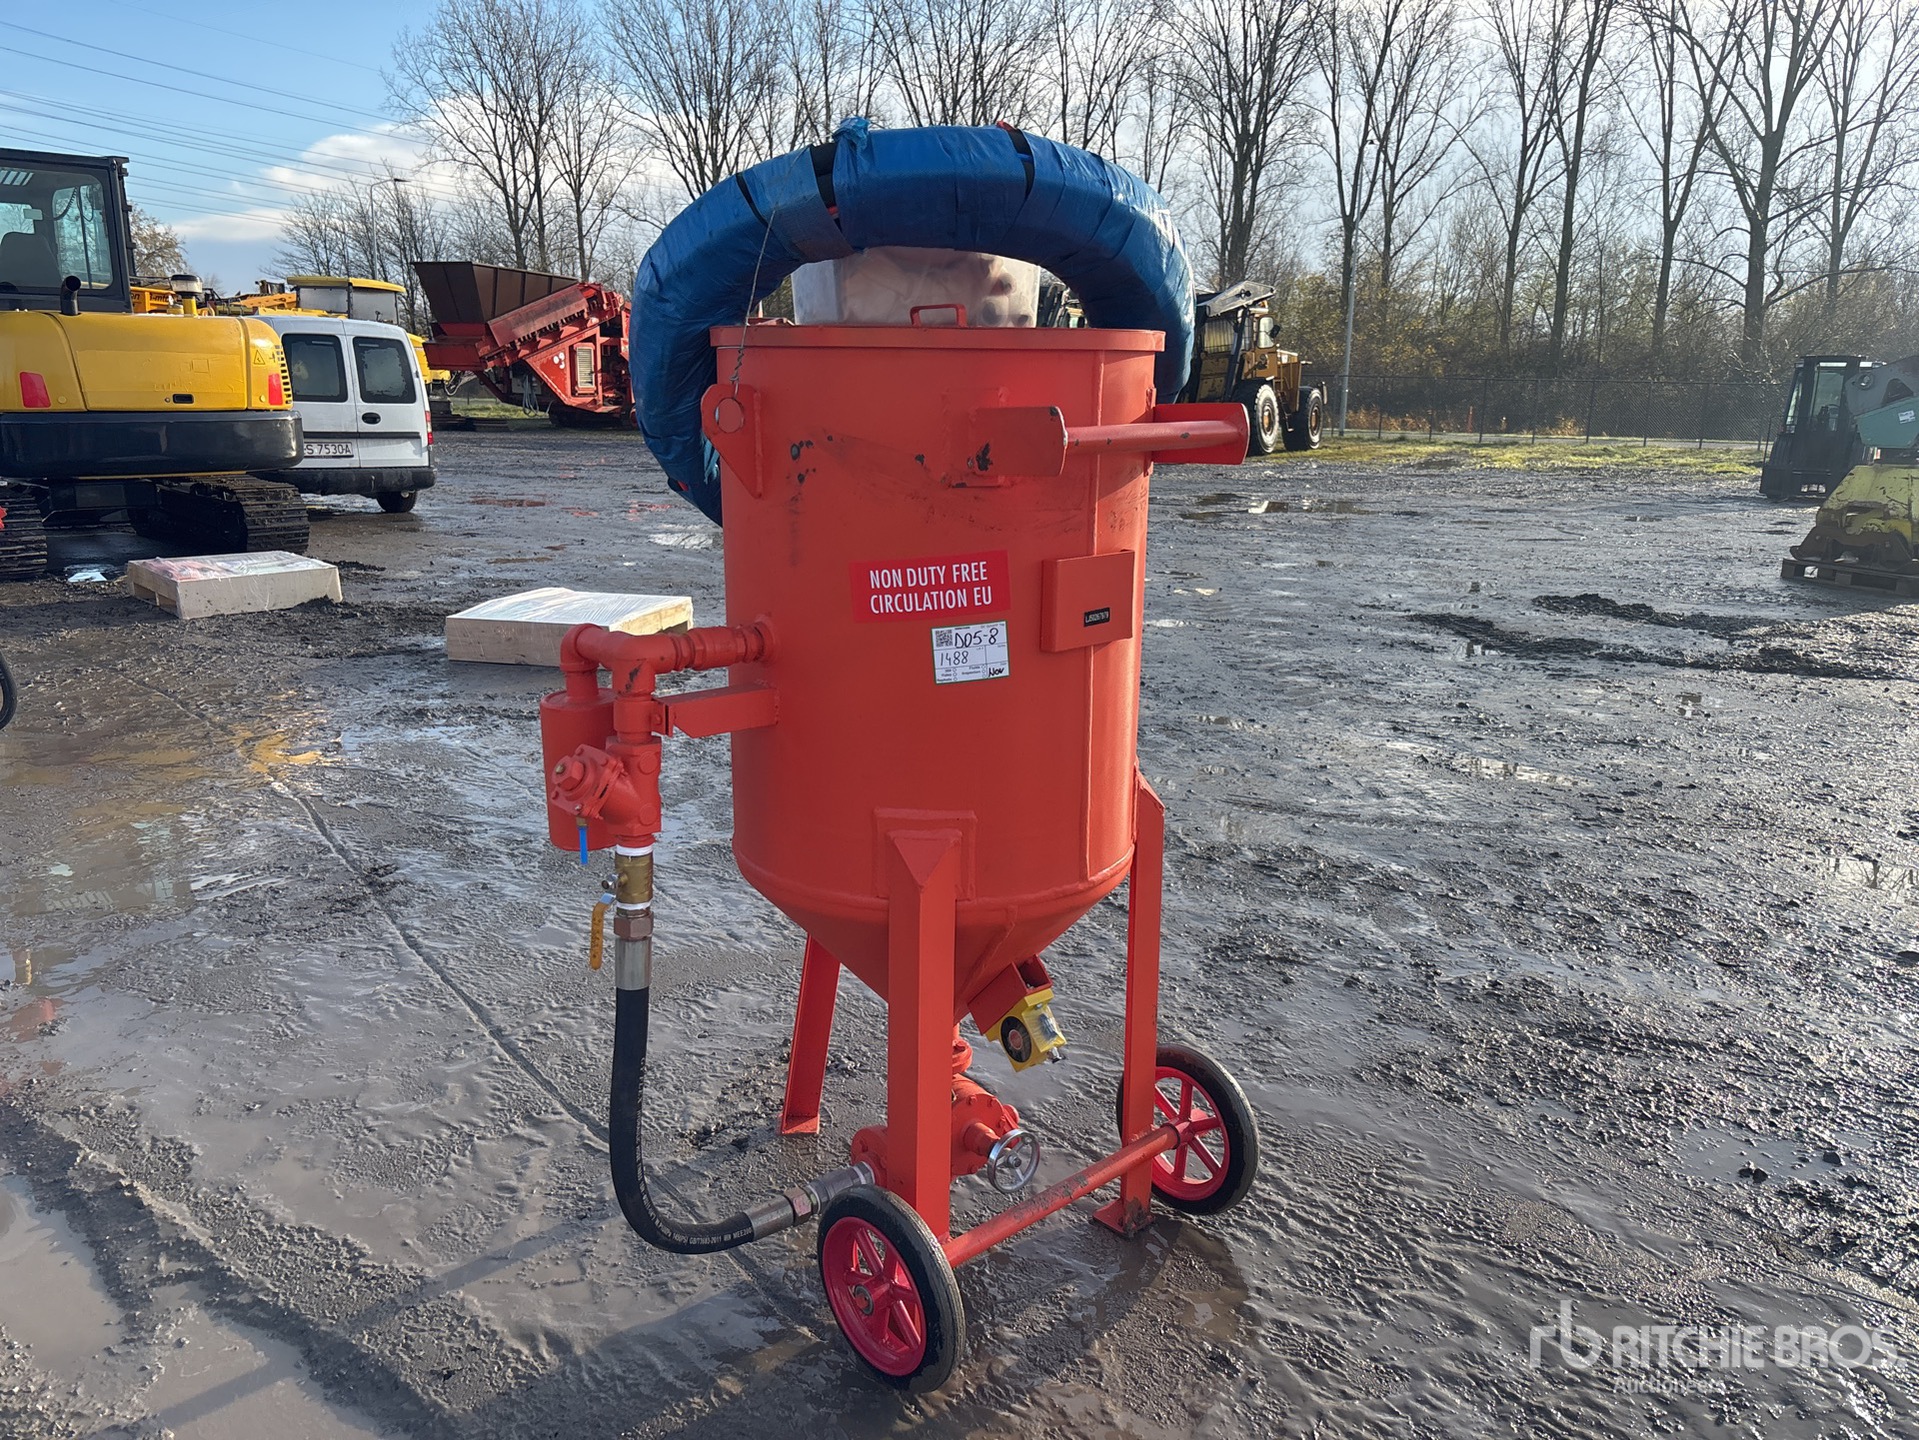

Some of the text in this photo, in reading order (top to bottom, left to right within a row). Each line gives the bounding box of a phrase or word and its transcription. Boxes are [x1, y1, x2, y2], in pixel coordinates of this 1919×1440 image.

[869, 561, 988, 589] NON DUTY FREE
[870, 585, 992, 614] CIRCULATION EU
[940, 650, 969, 667] 1488
